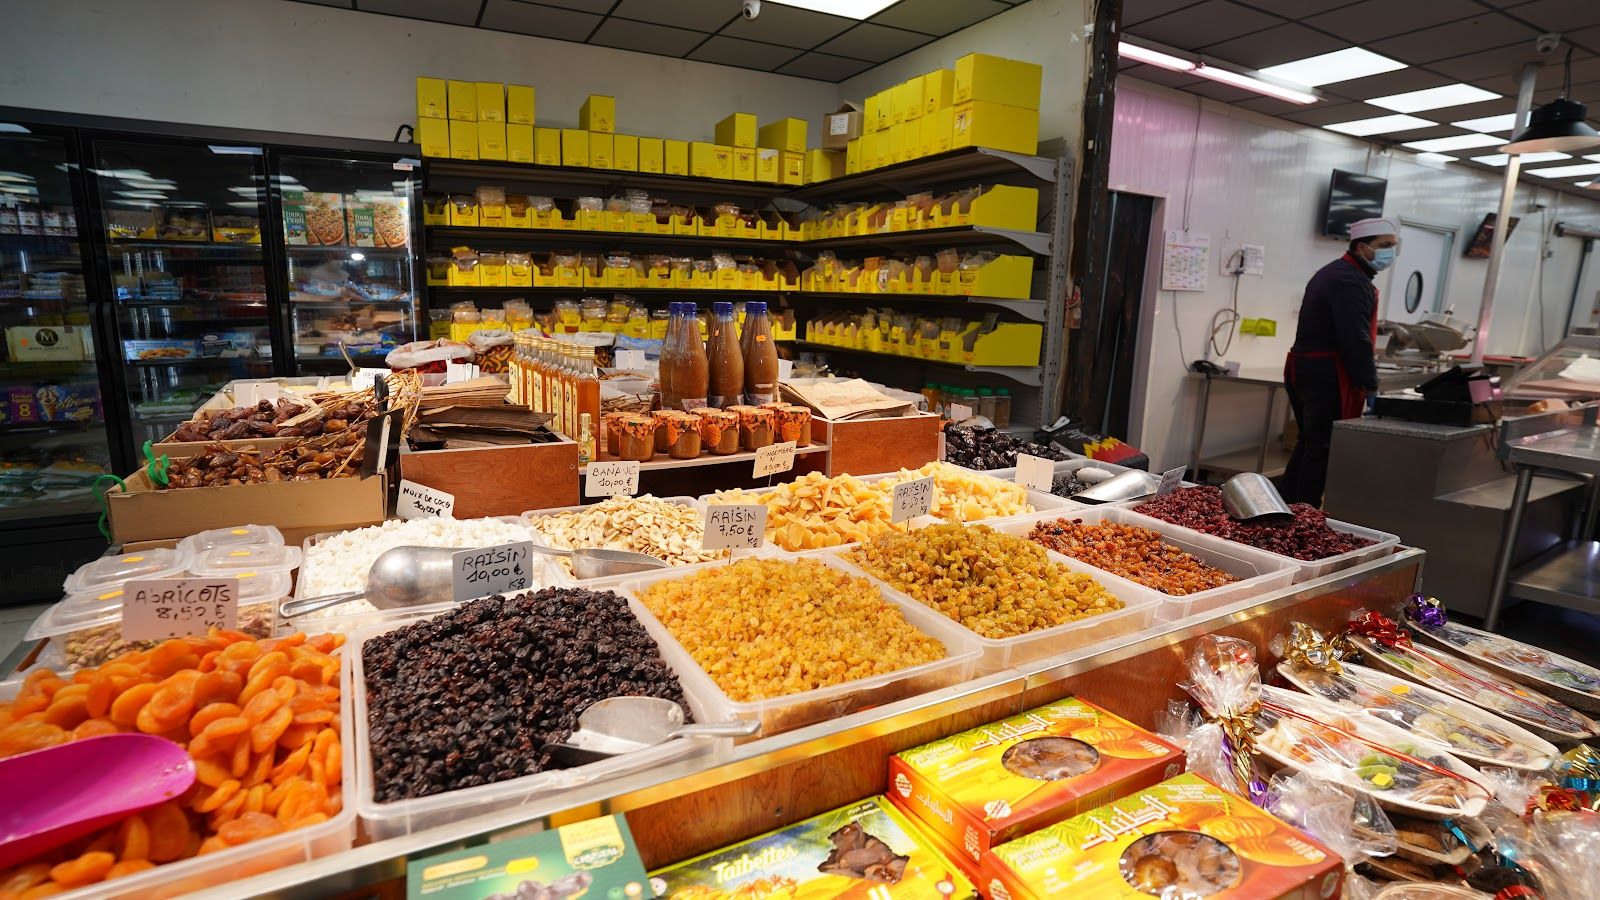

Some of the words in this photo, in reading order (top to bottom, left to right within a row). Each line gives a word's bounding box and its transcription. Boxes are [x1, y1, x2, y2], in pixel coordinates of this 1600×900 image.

[19, 403, 31, 417] 8
[710, 508, 757, 524] RAISIN
[719, 524, 745, 537] 7,50
[462, 547, 527, 572] RAISIN
[465, 567, 510, 583] 10,00
